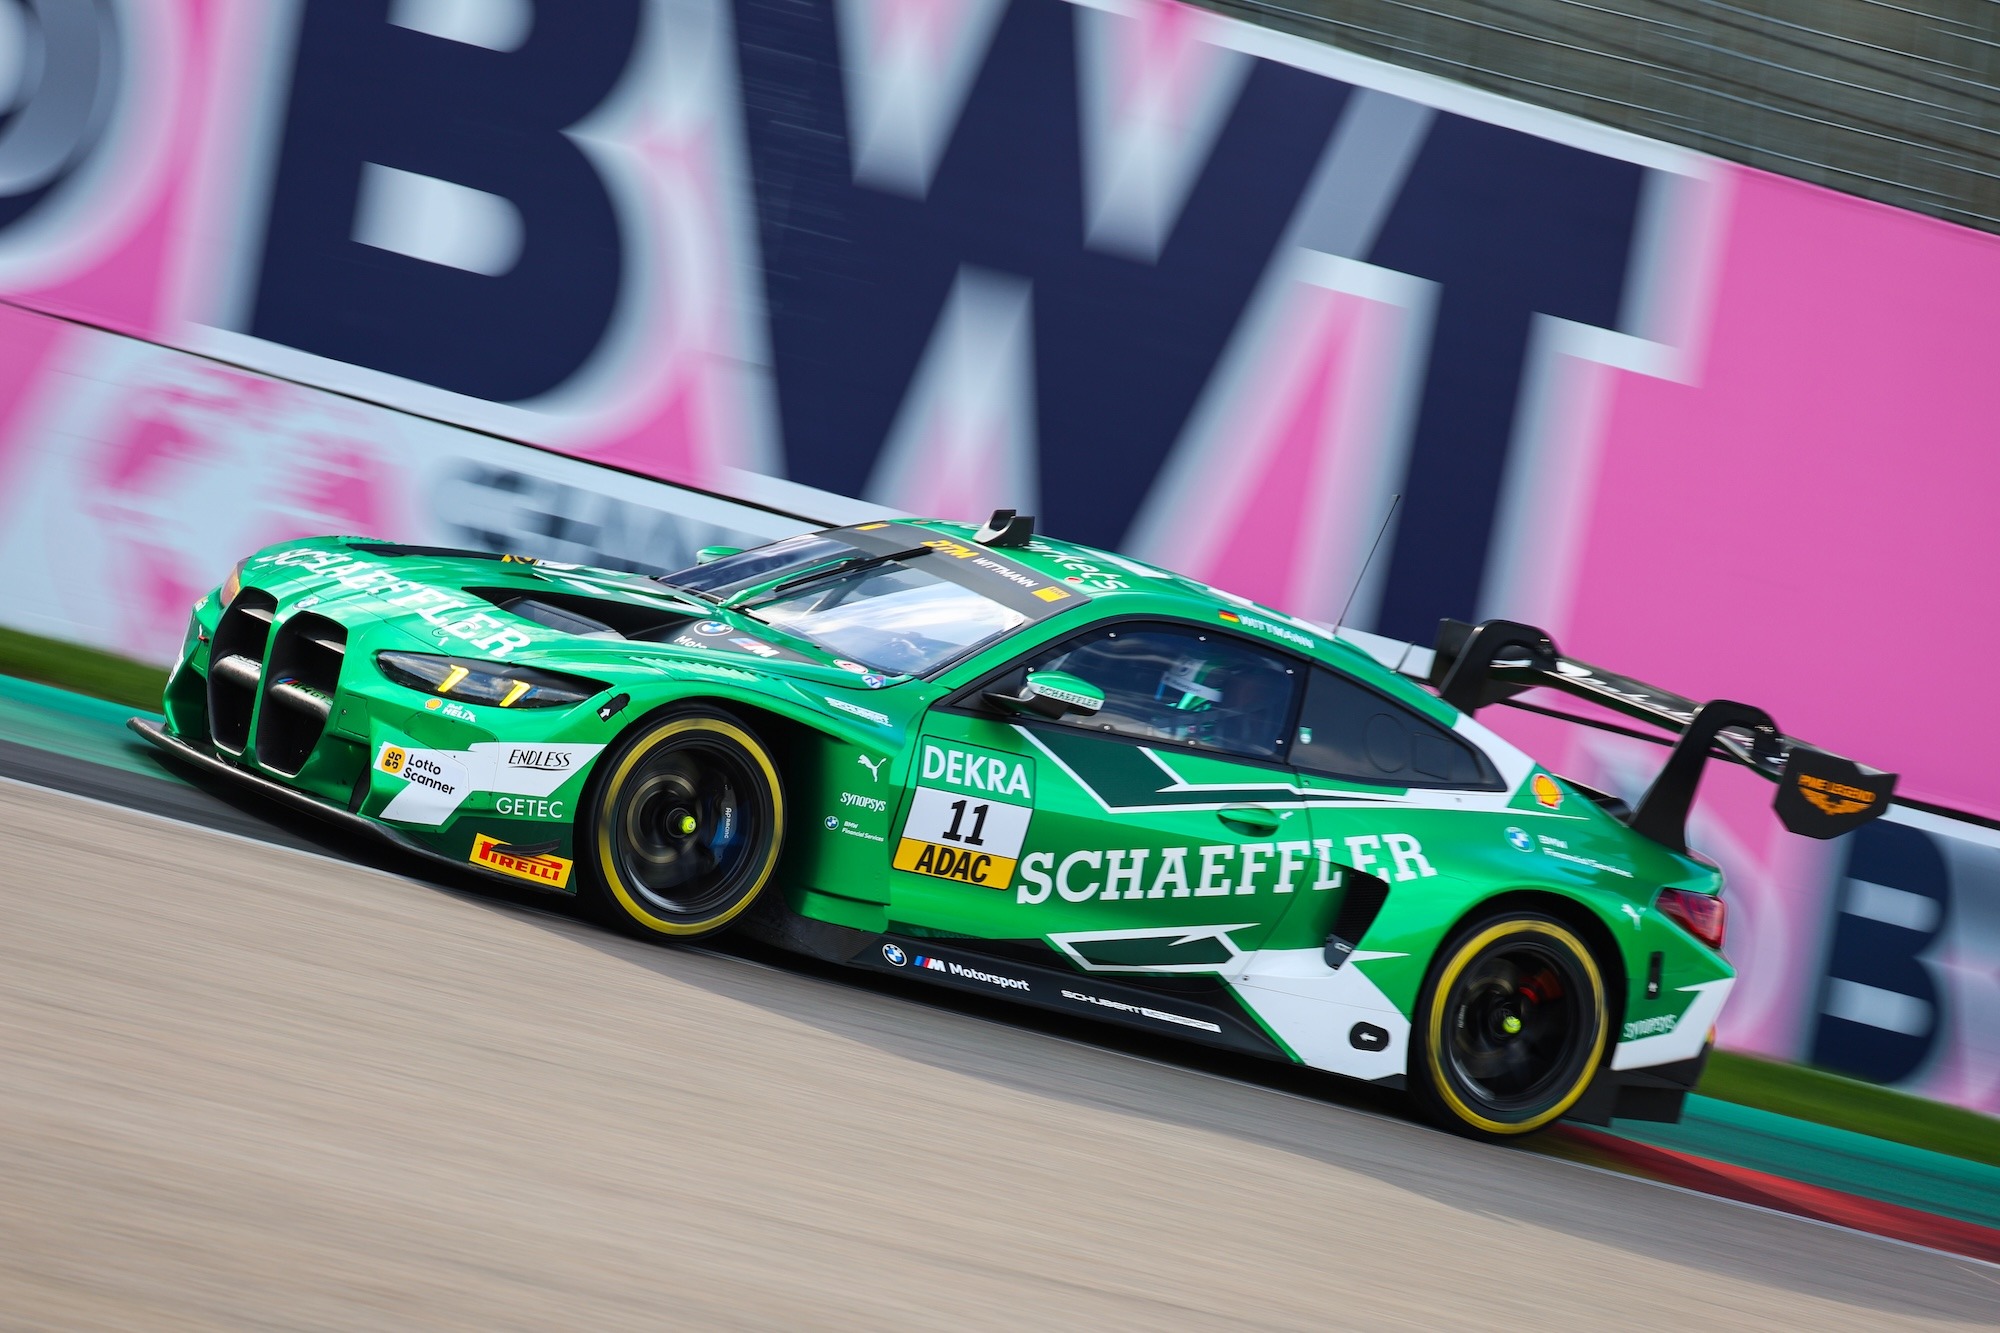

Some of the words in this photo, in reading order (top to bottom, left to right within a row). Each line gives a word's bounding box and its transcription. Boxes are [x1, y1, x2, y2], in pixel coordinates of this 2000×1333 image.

[246, 0, 1648, 635] BWT
[920, 540, 979, 559] DTM
[972, 557, 1039, 587] WITTMANN
[254, 548, 531, 657] SCHAEFFLER
[1039, 686, 1099, 709] SCHAEFFLER
[408, 754, 441, 775] Lotto
[508, 749, 572, 768] ENDLESS
[922, 745, 1031, 799] DEKRA
[403, 768, 455, 795] Scanner
[496, 797, 563, 818] GETEC
[942, 799, 990, 846] 11
[479, 841, 563, 881] PIRELLI
[914, 845, 991, 883] ADAC
[1017, 833, 1438, 905] SCHAEFFLER
[948, 962, 1030, 992] Motorsport
[1061, 990, 1142, 1014] SCHUBERT
